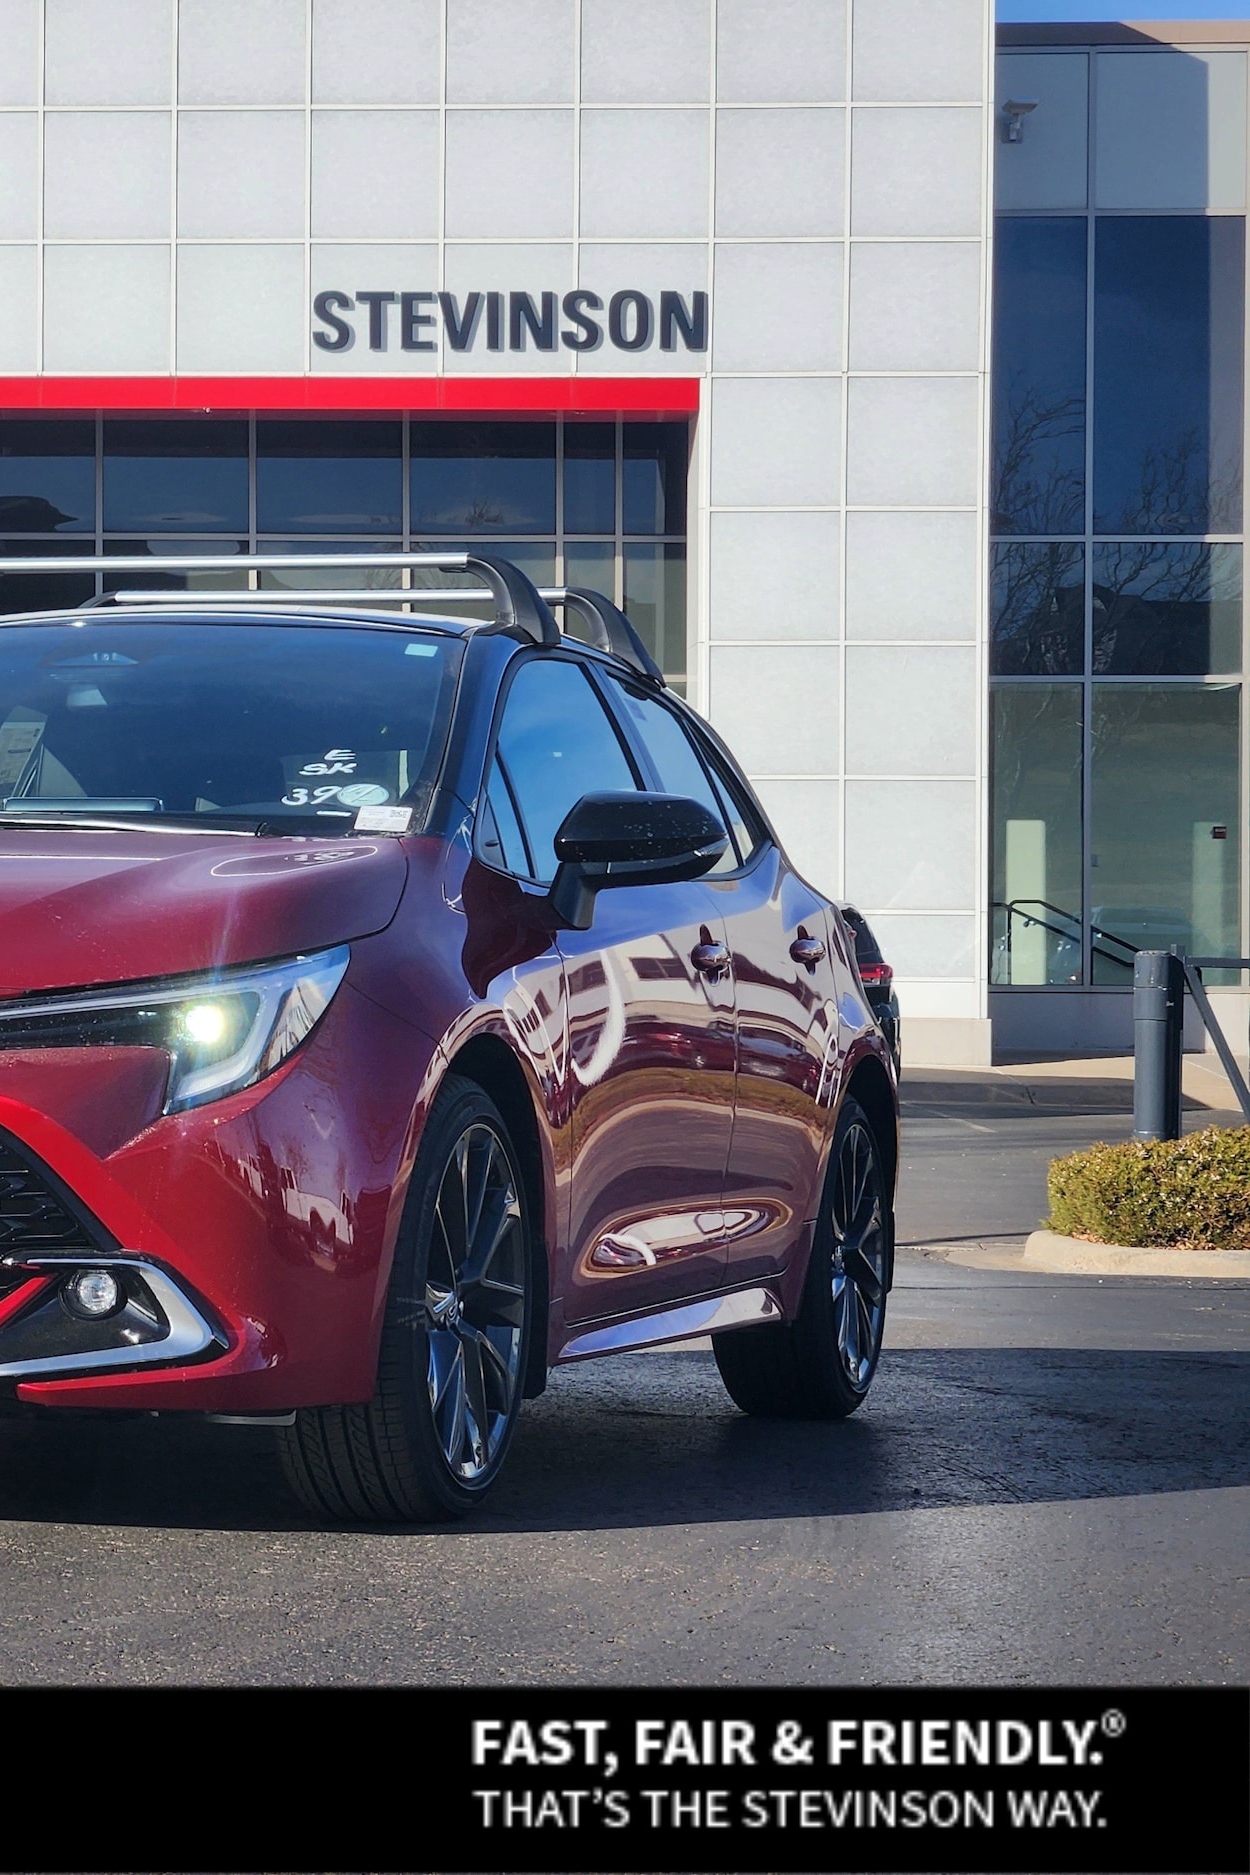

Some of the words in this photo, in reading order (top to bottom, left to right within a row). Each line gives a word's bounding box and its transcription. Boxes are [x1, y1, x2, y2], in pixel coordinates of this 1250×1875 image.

[312, 289, 707, 351] STEVINSON
[324, 749, 356, 761] E
[299, 762, 358, 776] SK
